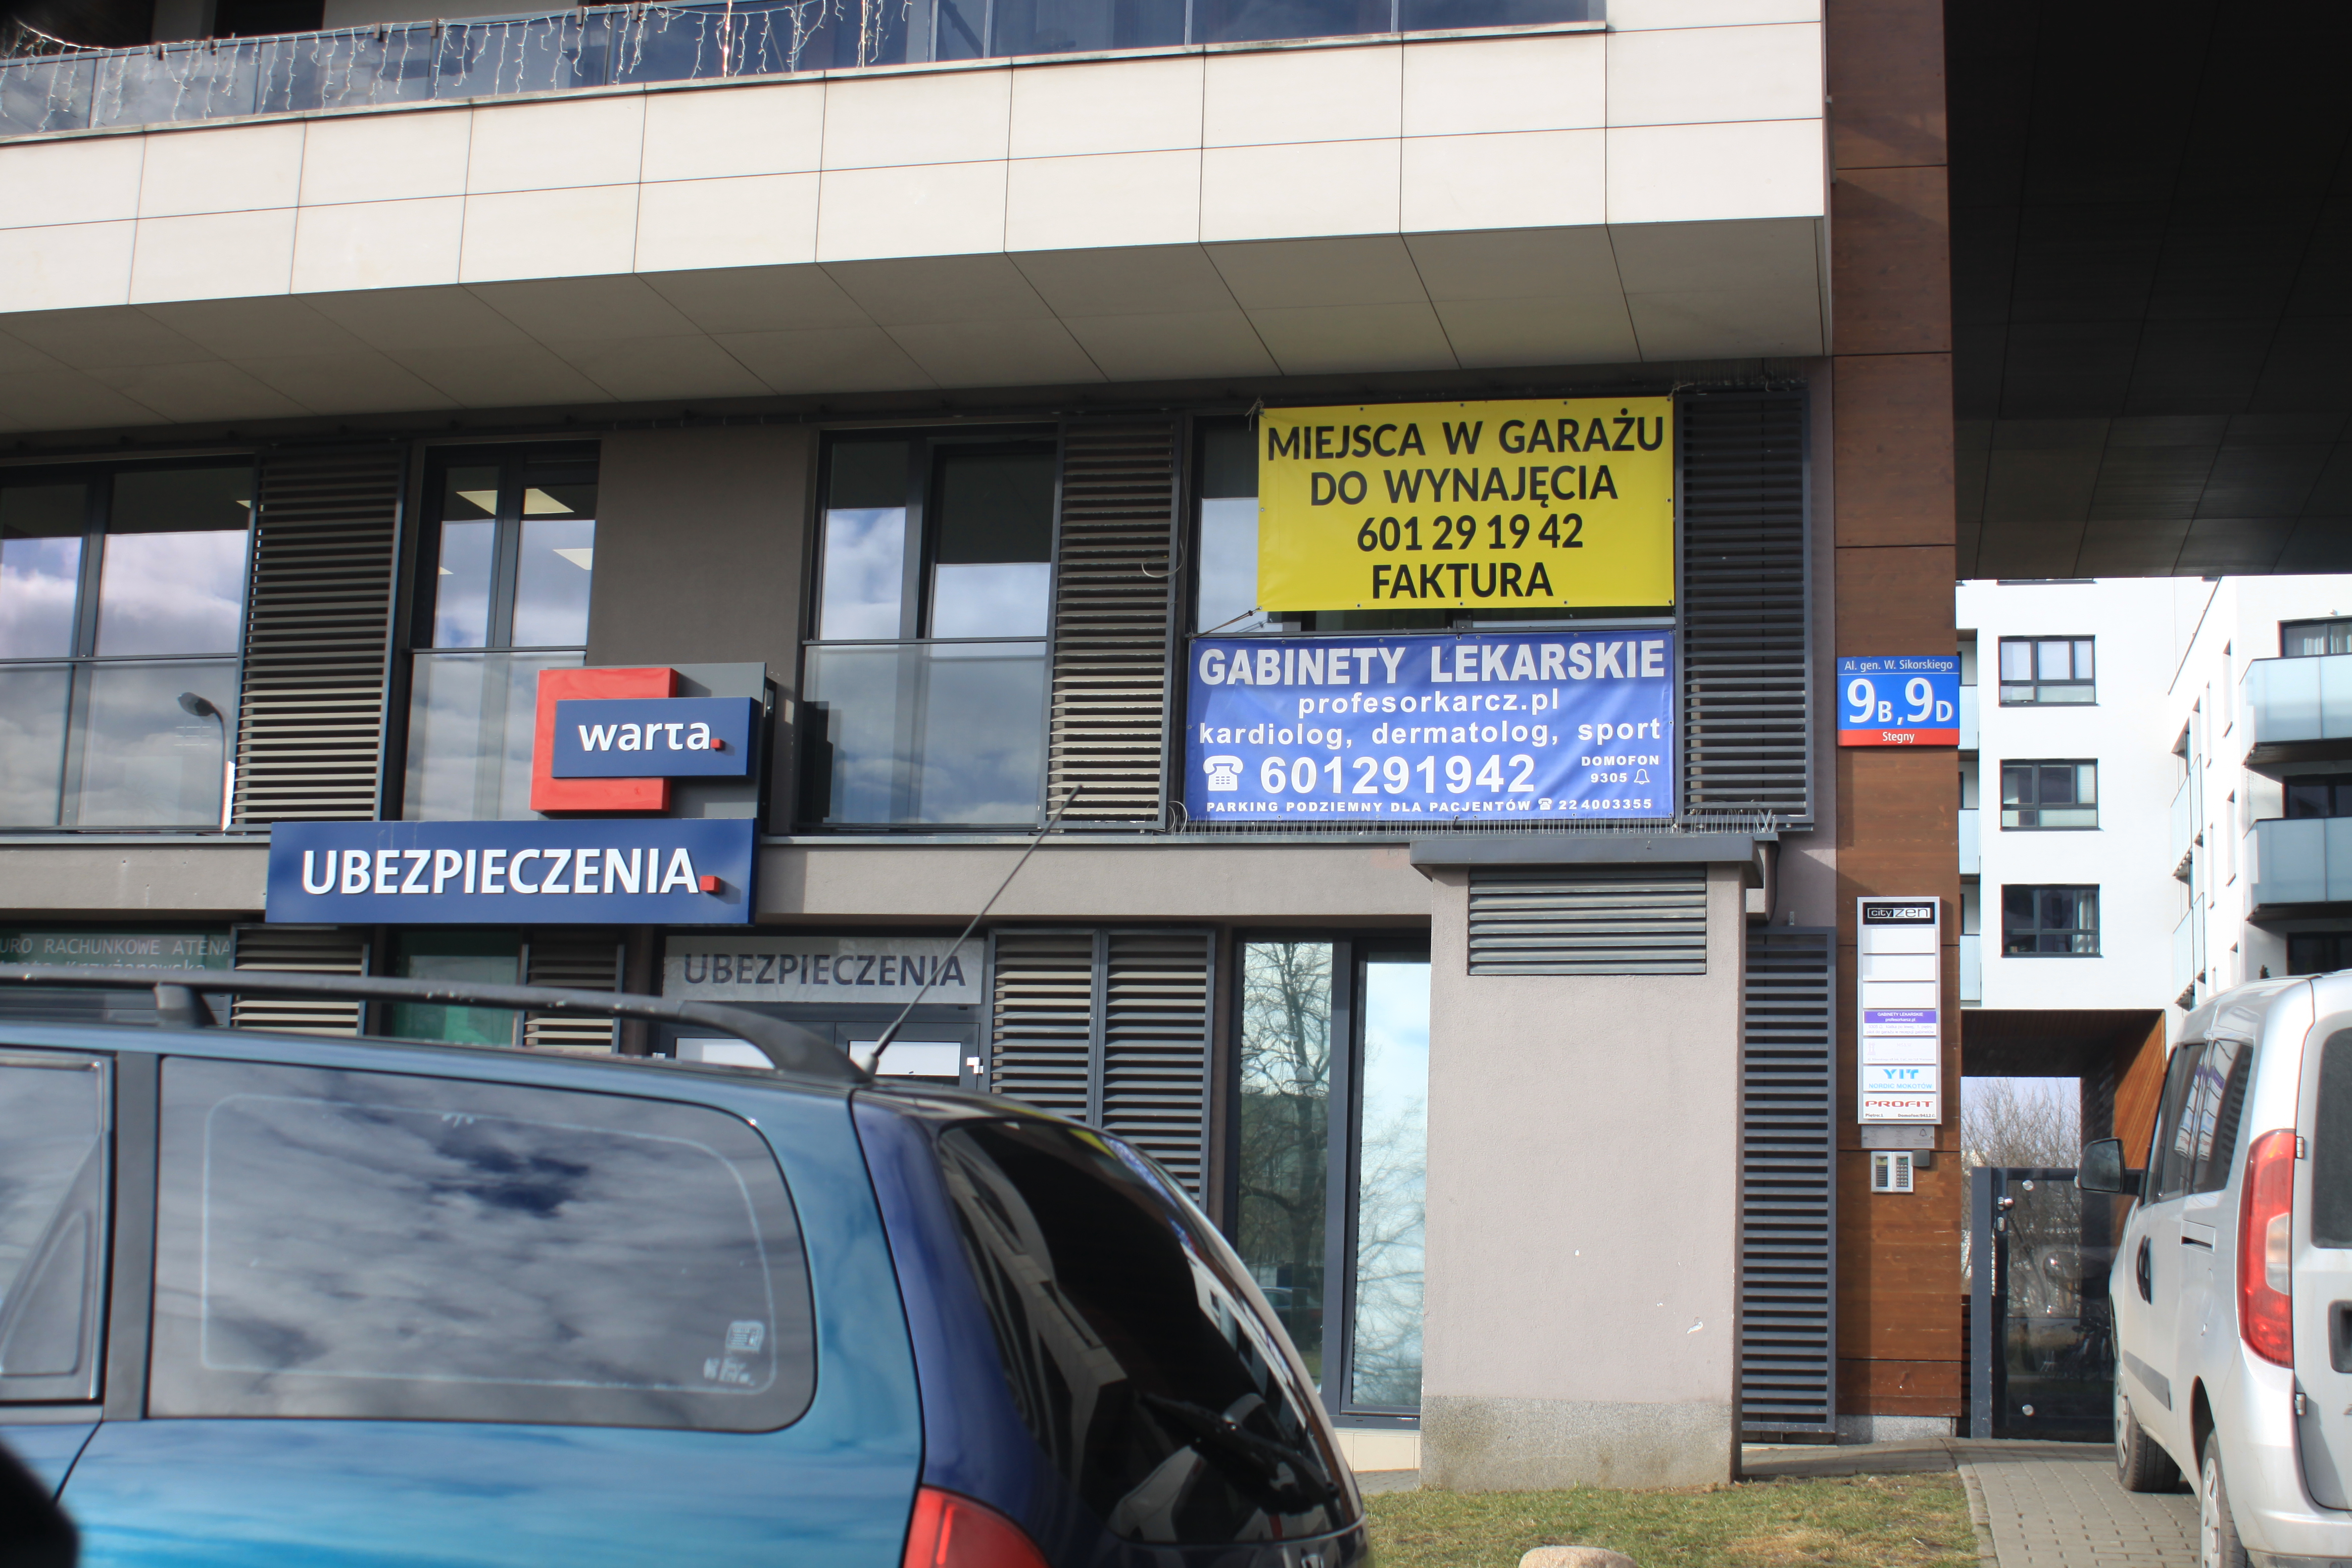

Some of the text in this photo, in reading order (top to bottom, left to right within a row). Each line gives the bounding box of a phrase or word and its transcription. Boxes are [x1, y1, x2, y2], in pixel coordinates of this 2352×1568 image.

[1268, 407, 1663, 461] MIEJSCA W GARAŻU
[1311, 465, 1618, 508] DO WYNAJĘCIA
[1357, 516, 1422, 552] 601
[1372, 562, 1554, 599] FAKTURA
[1199, 639, 1665, 686] GABINETY LEKARSKIE
[1844, 659, 1953, 672] Al. gen. W. Sikorskiego
[1299, 688, 1559, 718] profesorkarcz.pl
[1200, 718, 1661, 749] kardiolog, dermatolog, sport
[1882, 732, 1915, 743] Stegny
[1260, 754, 1536, 794] 601291942
[1581, 755, 1660, 766] DOMOFON
[1590, 773, 1627, 783] 9305
[1207, 802, 1278, 812] PARKING
[1286, 802, 1382, 812] PODZIEMNY
[1390, 802, 1422, 812] DLA
[1429, 798, 1531, 812] PACJENTÓW
[44, 938, 160, 955] RACHUNKOWE
[684, 953, 966, 986] UBEZPIECZENIA
[1882, 1069, 1919, 1079] YIT
